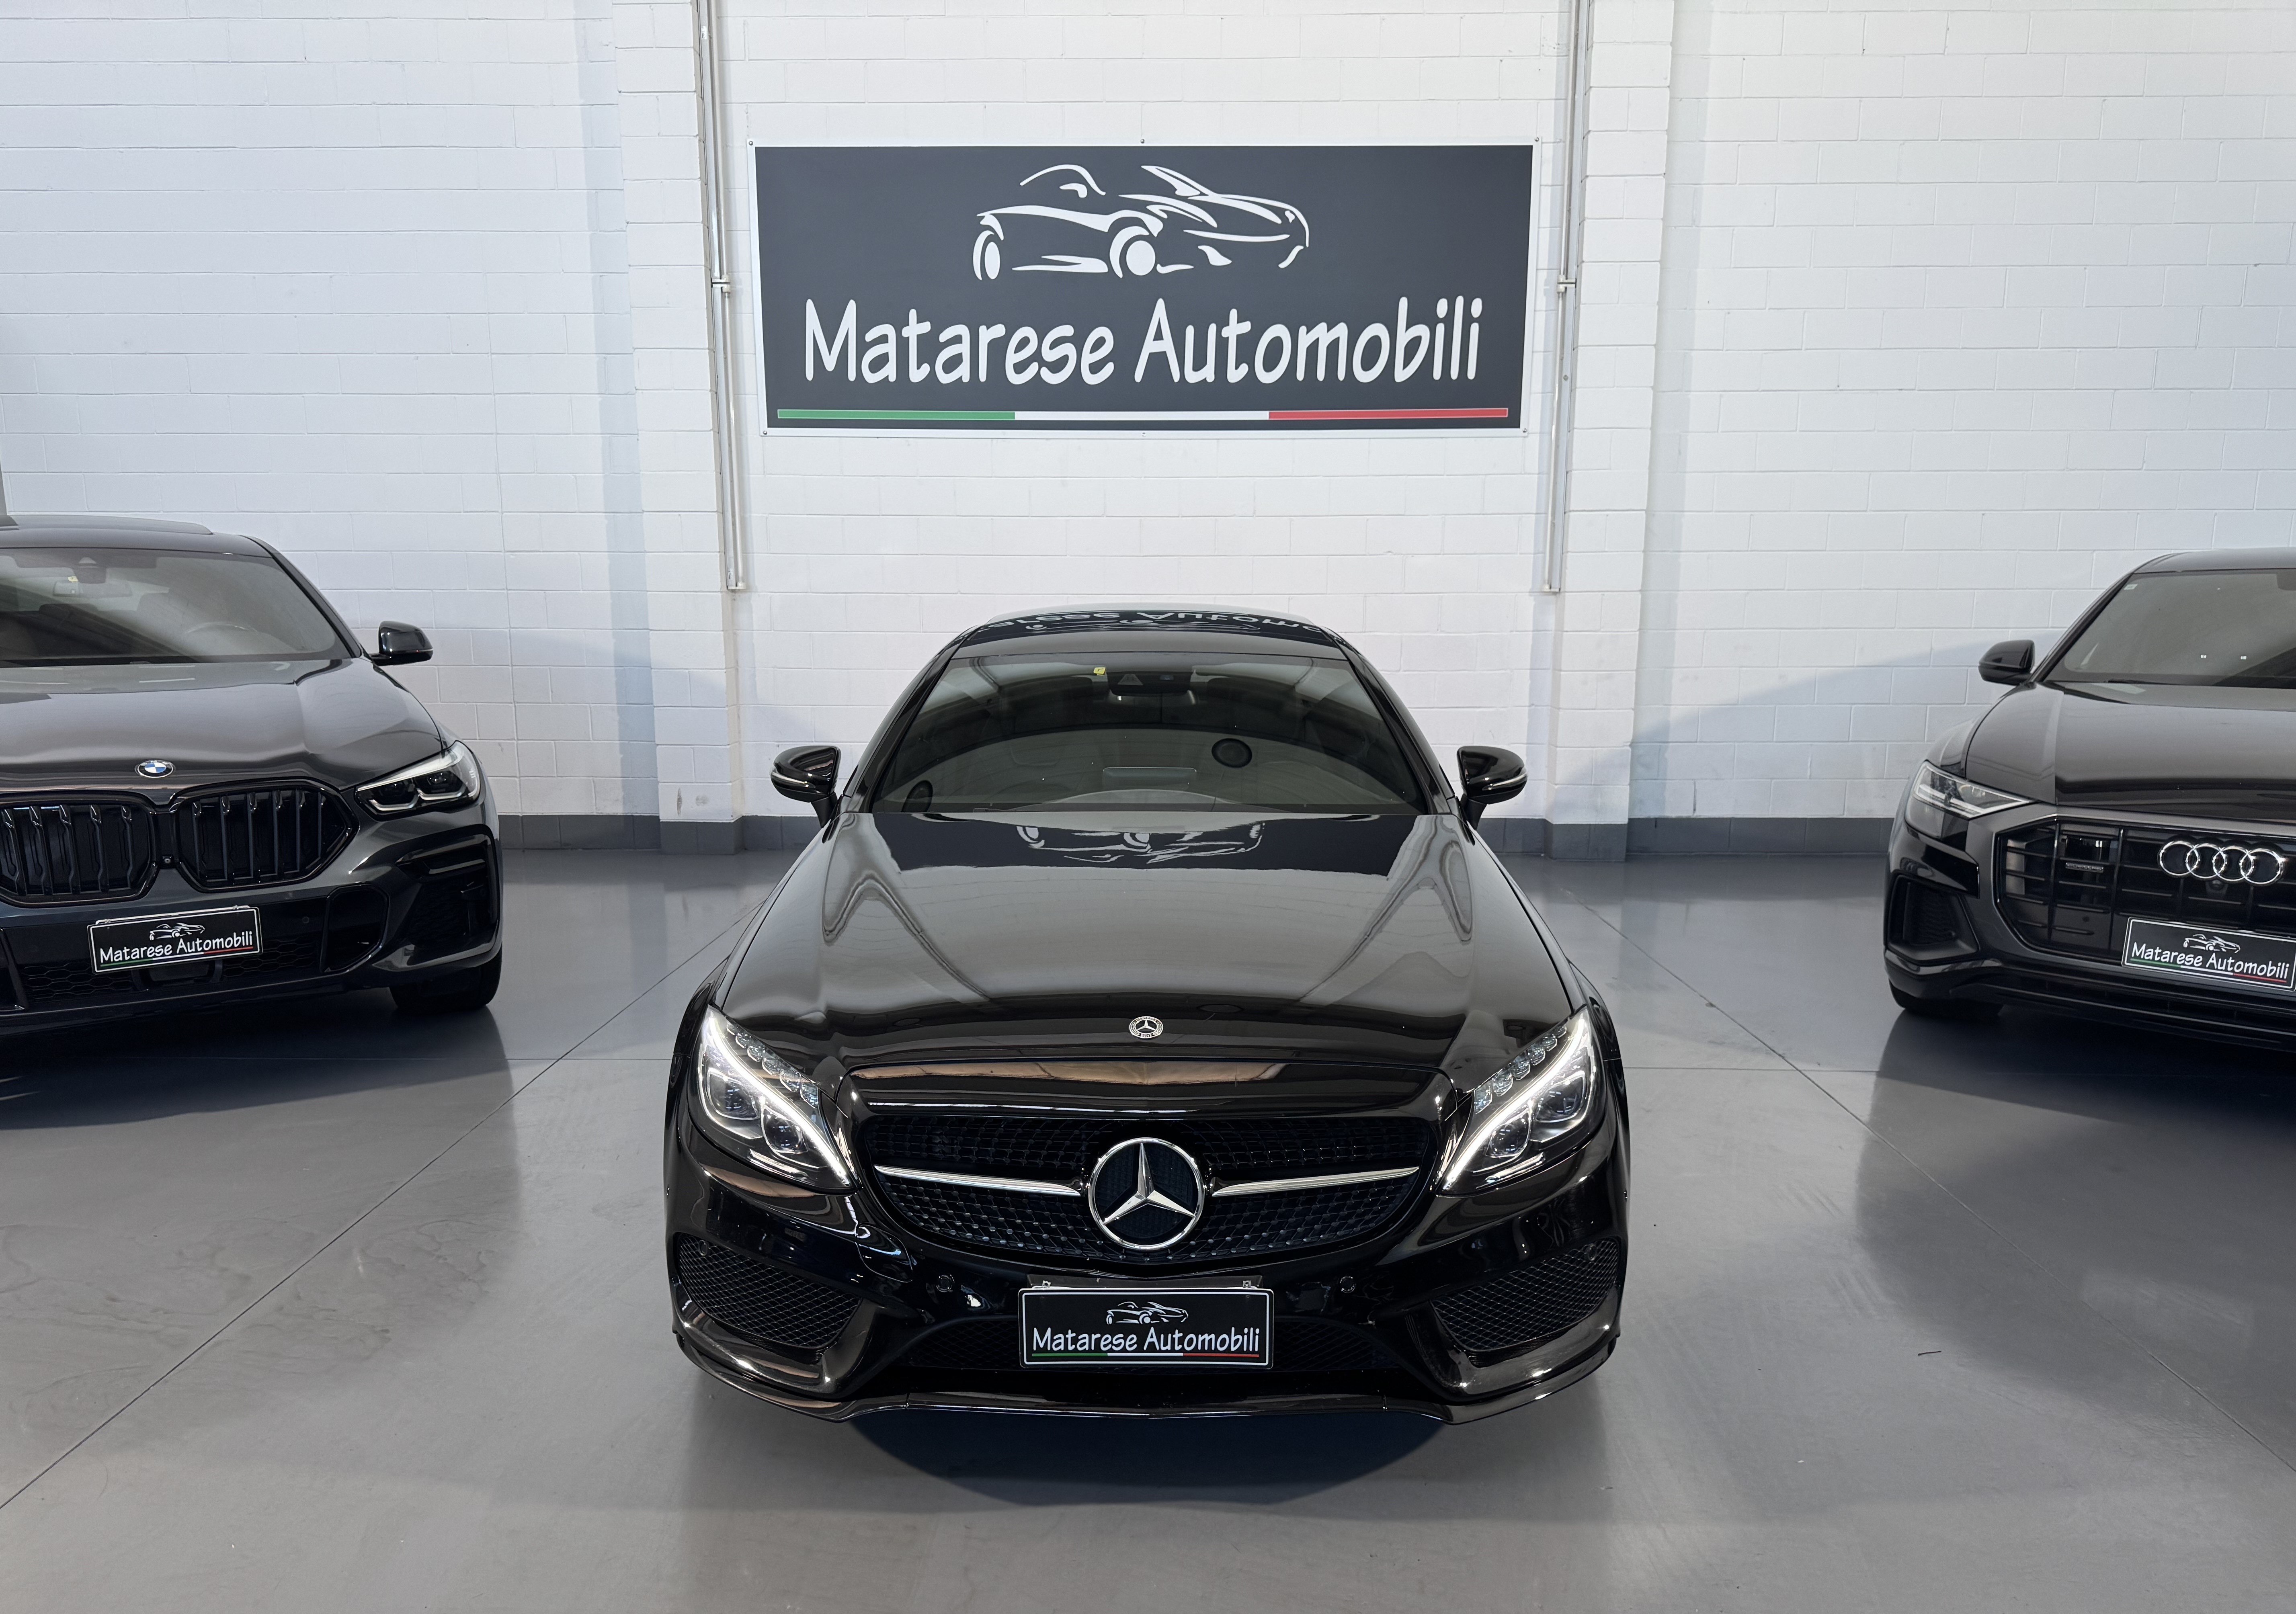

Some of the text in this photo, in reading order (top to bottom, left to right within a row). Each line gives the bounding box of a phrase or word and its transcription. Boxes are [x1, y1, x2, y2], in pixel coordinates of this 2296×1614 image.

[805, 295, 1482, 385] Matarese Automobili
[100, 931, 253, 963] Matarese Automobili
[2132, 942, 2290, 979] Matarese Automobili
[1033, 1327, 1259, 1352] Matarese Automobili
